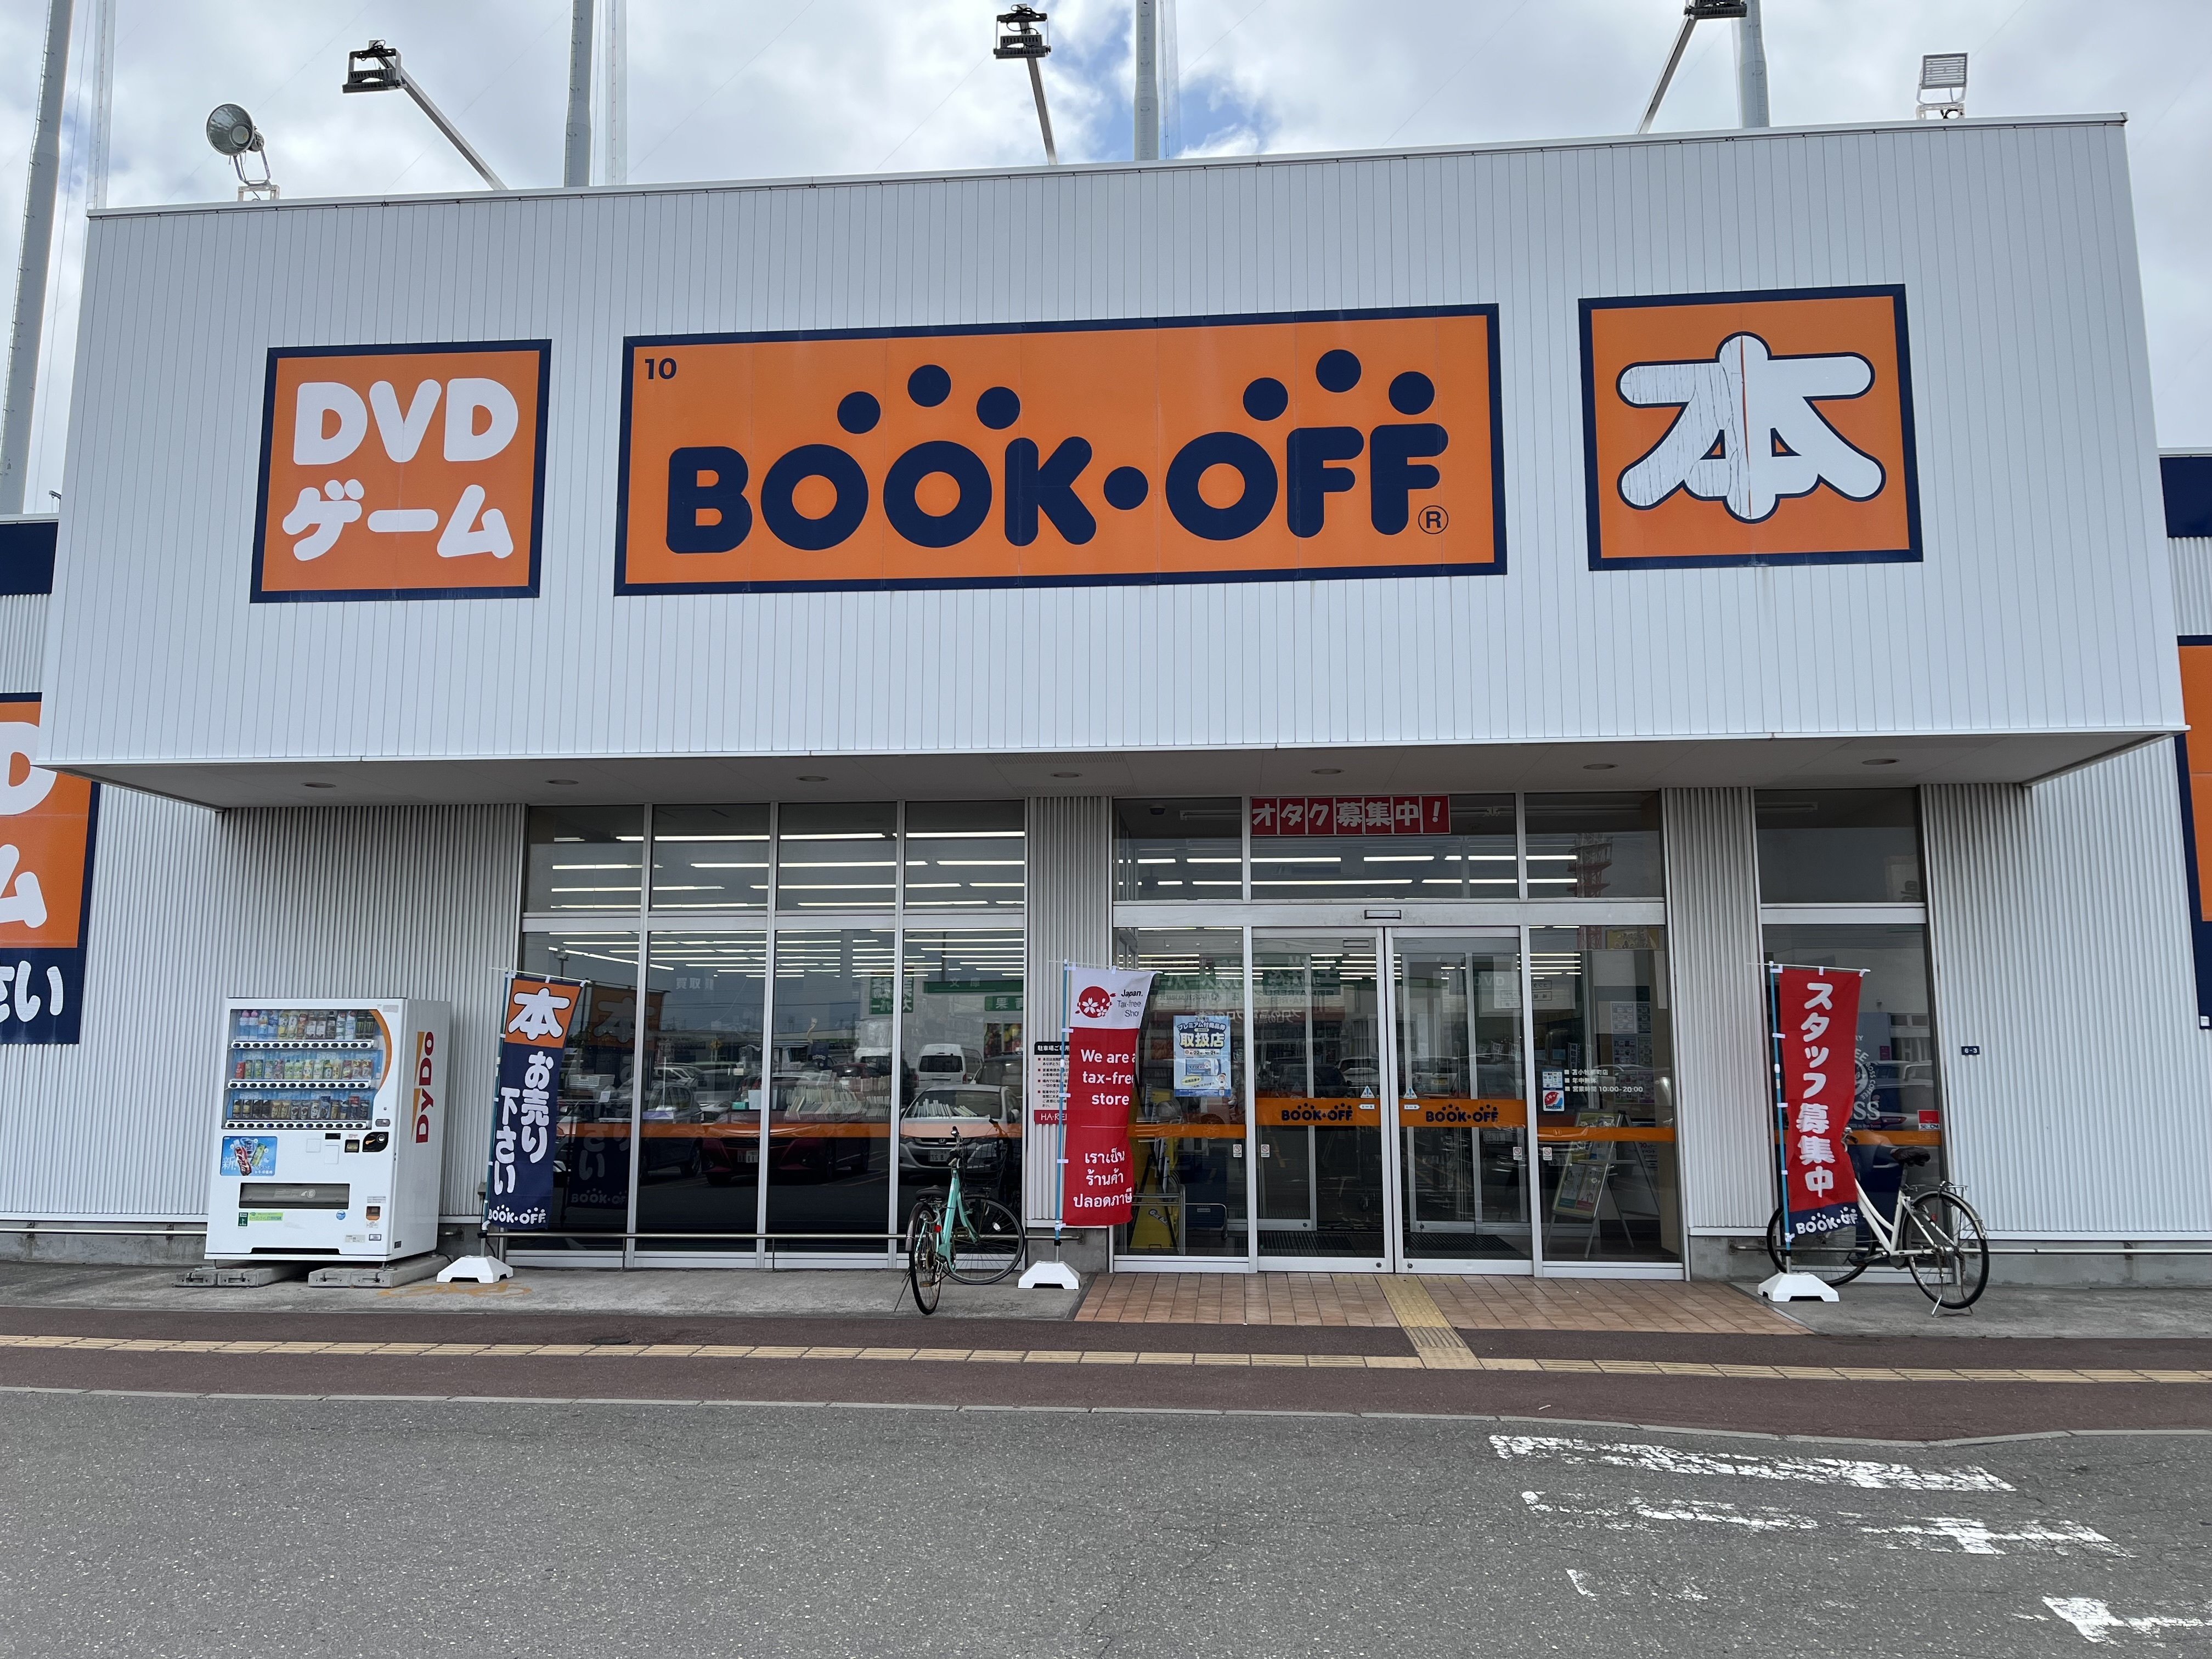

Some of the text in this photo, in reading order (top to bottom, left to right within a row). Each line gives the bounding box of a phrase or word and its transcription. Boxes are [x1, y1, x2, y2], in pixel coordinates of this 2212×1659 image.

[644, 358, 677, 380] 10
[294, 377, 518, 465] DVD
[1616, 331, 1886, 524] 本
[282, 478, 514, 561] ゲーム
[1252, 800, 1441, 827] オタク募集中！
[507, 988, 571, 1041] 本
[1180, 1032, 1226, 1047] 取扱店
[1080, 1049, 1103, 1063] We
[1107, 1052, 1130, 1063] are
[1091, 1093, 1130, 1105] store
[1796, 983, 1836, 1198] スタッフ募集中
[521, 1051, 554, 1164] お売り
[494, 1086, 521, 1196] 下さい
[1085, 1147, 1125, 1165] เราเป็น
[1085, 1168, 1124, 1187] ร้านค้า
[1073, 1187, 1133, 1208] ปลอดภาษี
